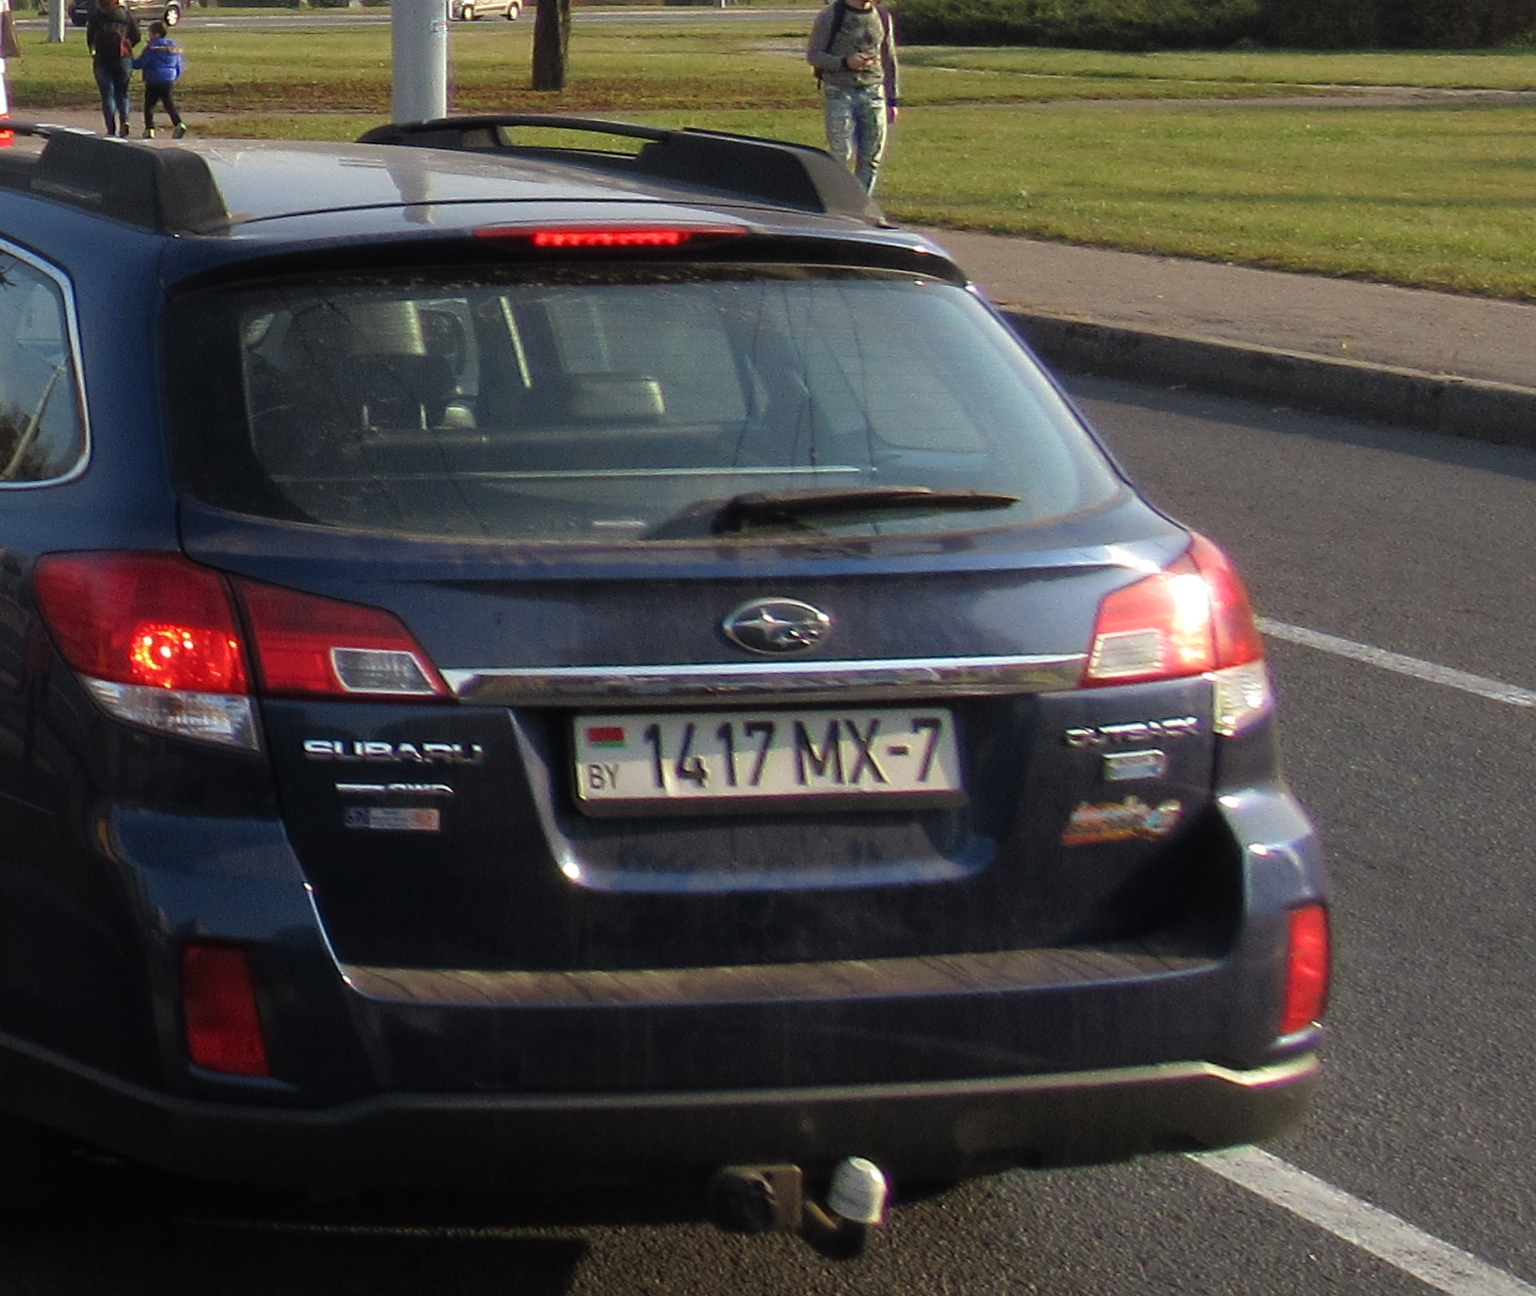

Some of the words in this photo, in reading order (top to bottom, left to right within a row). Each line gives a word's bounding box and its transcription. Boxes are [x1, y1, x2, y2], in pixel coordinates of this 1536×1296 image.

[302, 739, 485, 765] SUBARU
[643, 722, 776, 789] 1417
[793, 717, 942, 787] MX-7
[587, 764, 622, 791] BY
